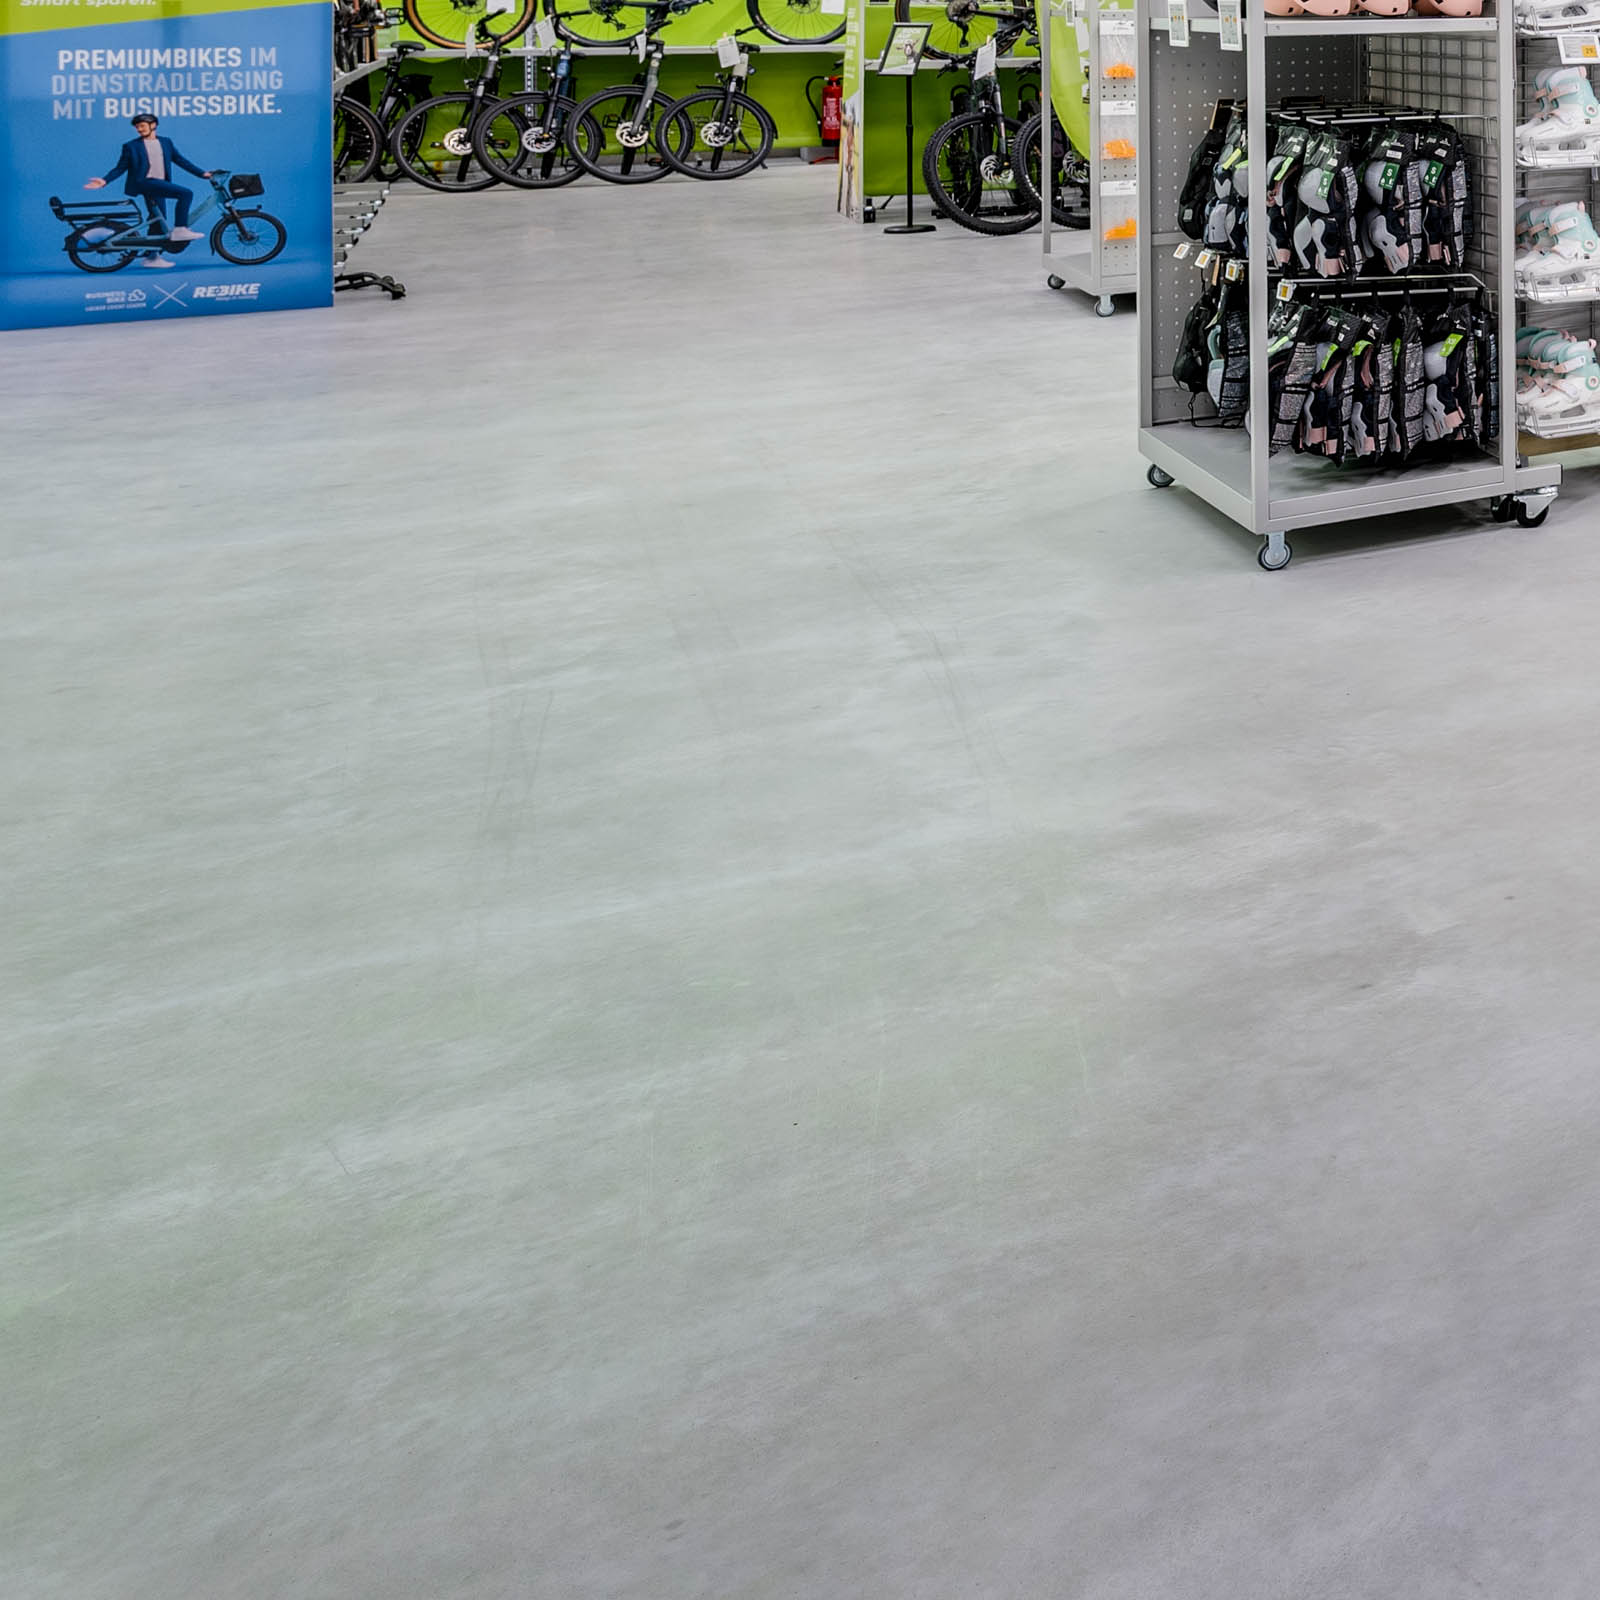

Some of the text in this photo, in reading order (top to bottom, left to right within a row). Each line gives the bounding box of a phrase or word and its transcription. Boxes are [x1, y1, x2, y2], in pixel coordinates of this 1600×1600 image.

[58, 47, 277, 71] PREMIUMBIKES IM
[52, 71, 284, 96] DIENSTRADLEASING
[53, 93, 282, 120] MIT BUSINESSBIKE.
[194, 283, 261, 299] REBIKE
